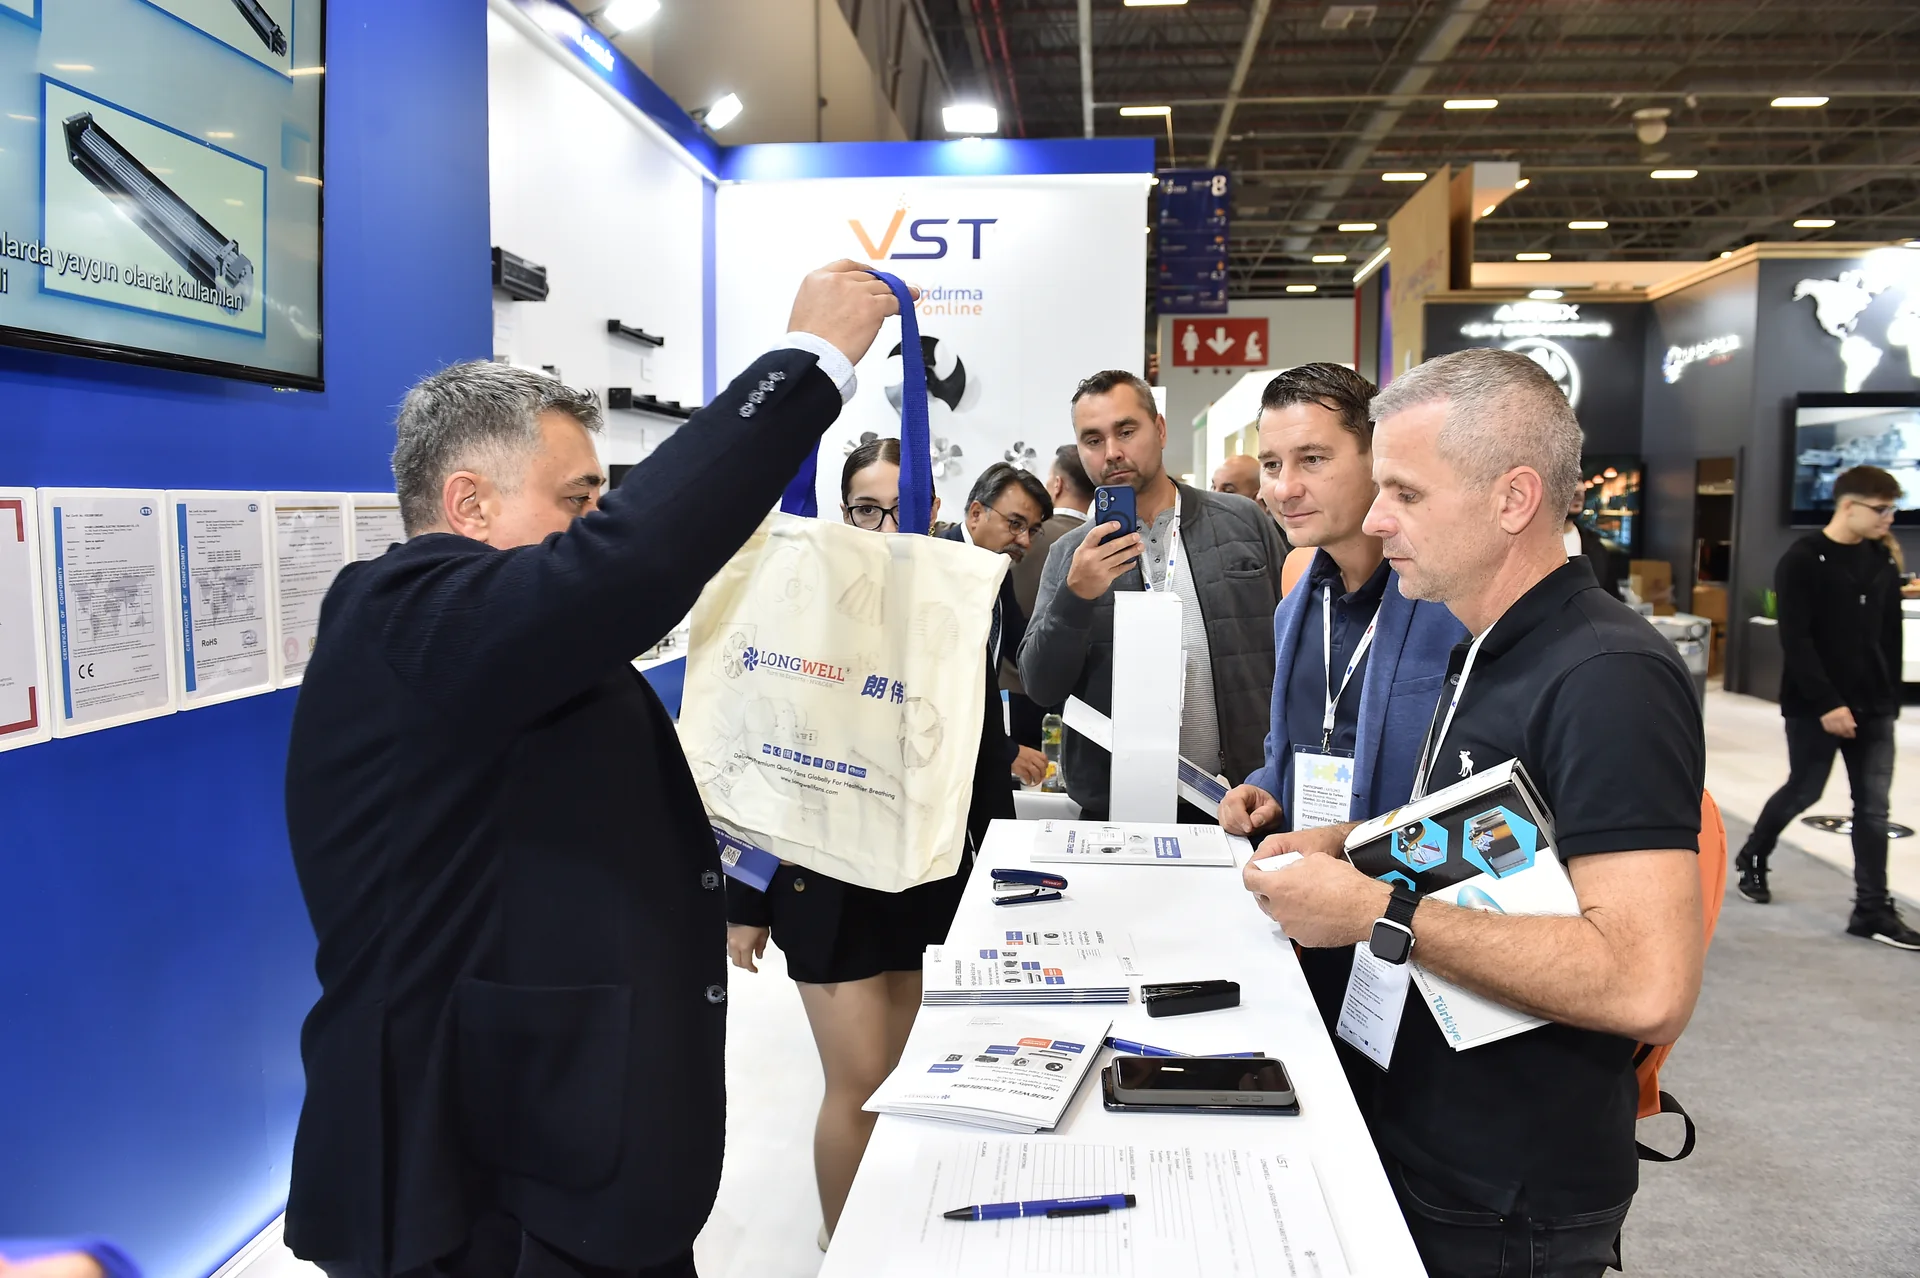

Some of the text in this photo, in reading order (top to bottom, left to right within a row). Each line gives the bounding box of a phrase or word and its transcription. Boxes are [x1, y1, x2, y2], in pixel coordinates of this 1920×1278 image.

[1211, 175, 1227, 197] 8
[848, 207, 998, 260] VST
[0, 231, 245, 312] larda yaygın olarak kullanılan
[920, 285, 983, 301] ndırma
[922, 302, 983, 316] online
[179, 544, 187, 589] CONFORMITY
[60, 623, 68, 660] CERTIFICATE
[183, 609, 191, 652] CERTIFICATE
[201, 637, 218, 648] RoHS
[78, 662, 95, 679] CE
[760, 650, 845, 682] LONGWELL
[776, 764, 793, 774] Quality
[794, 769, 806, 778] Fans
[807, 773, 831, 784] Globally
[832, 778, 842, 786] For
[844, 780, 868, 792] Healthier
[868, 787, 896, 800] Breathing
[1433, 995, 1462, 1042] Türkiye
[1277, 1153, 1291, 1168] VST
